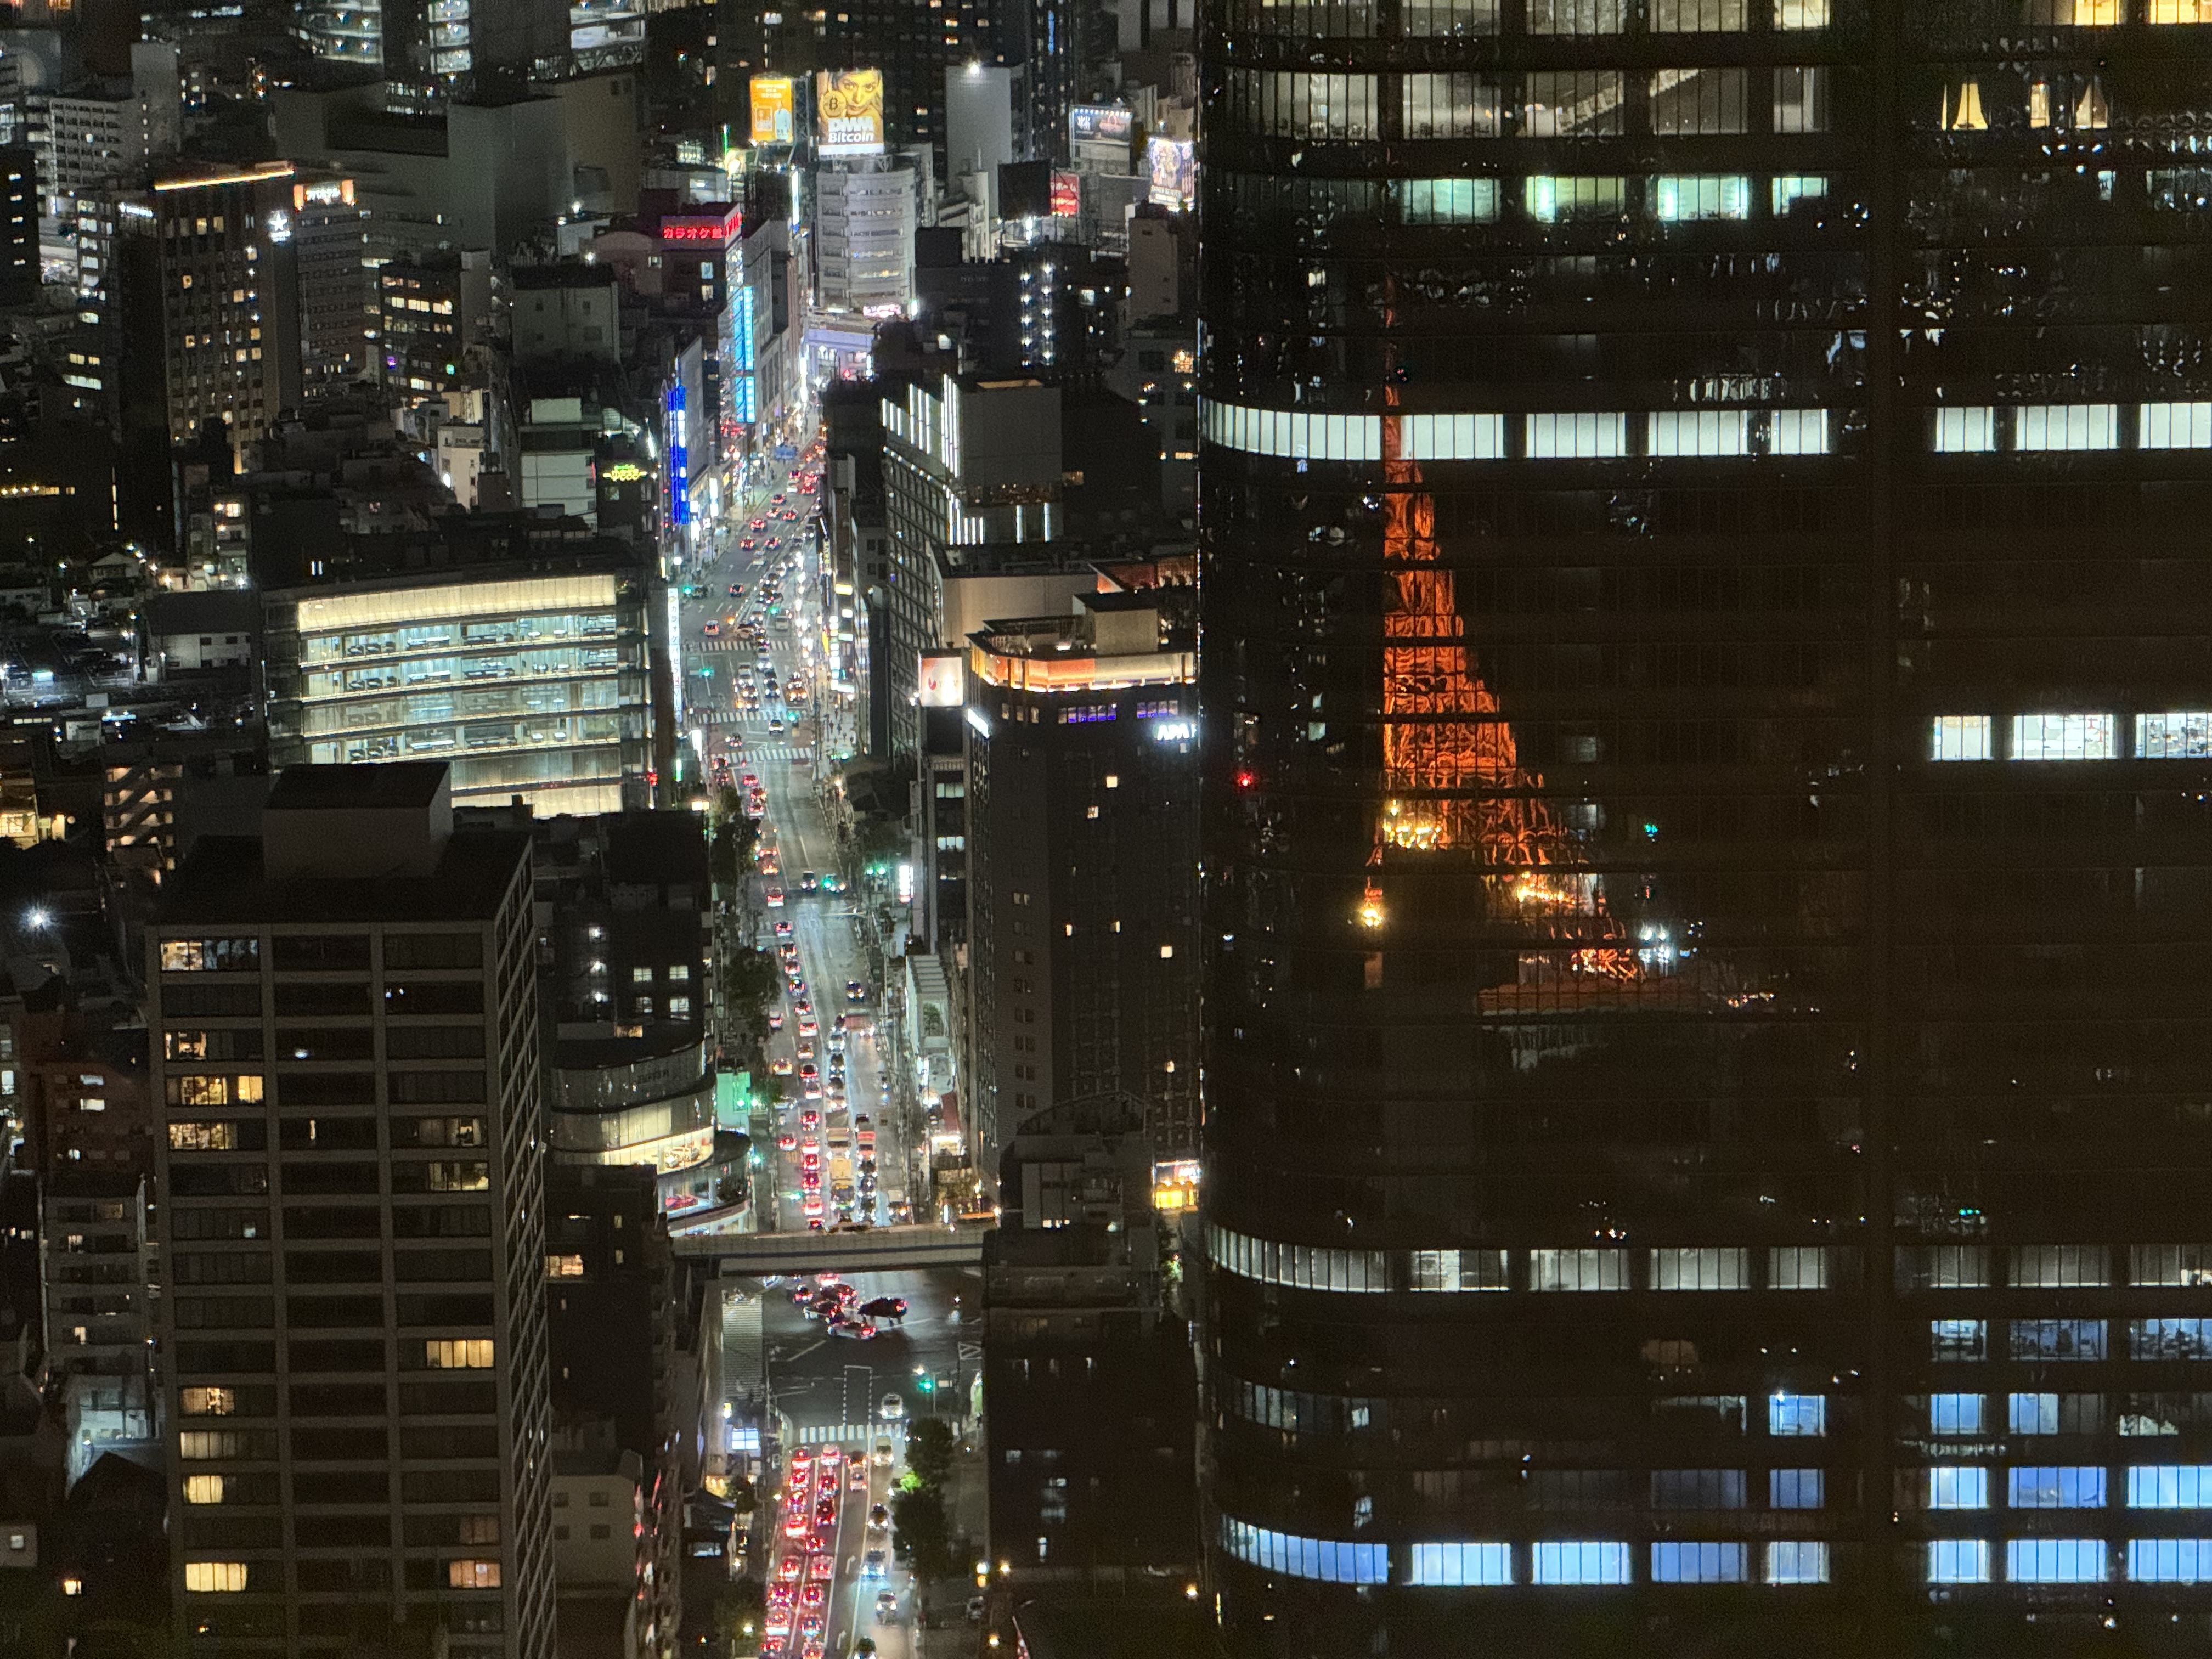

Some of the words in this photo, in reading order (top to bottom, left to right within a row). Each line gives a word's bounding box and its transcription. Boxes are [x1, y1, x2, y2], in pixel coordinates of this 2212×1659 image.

[828, 117, 874, 132] DMM
[828, 130, 874, 143] Bitcoin
[1157, 724, 1189, 740] APA
